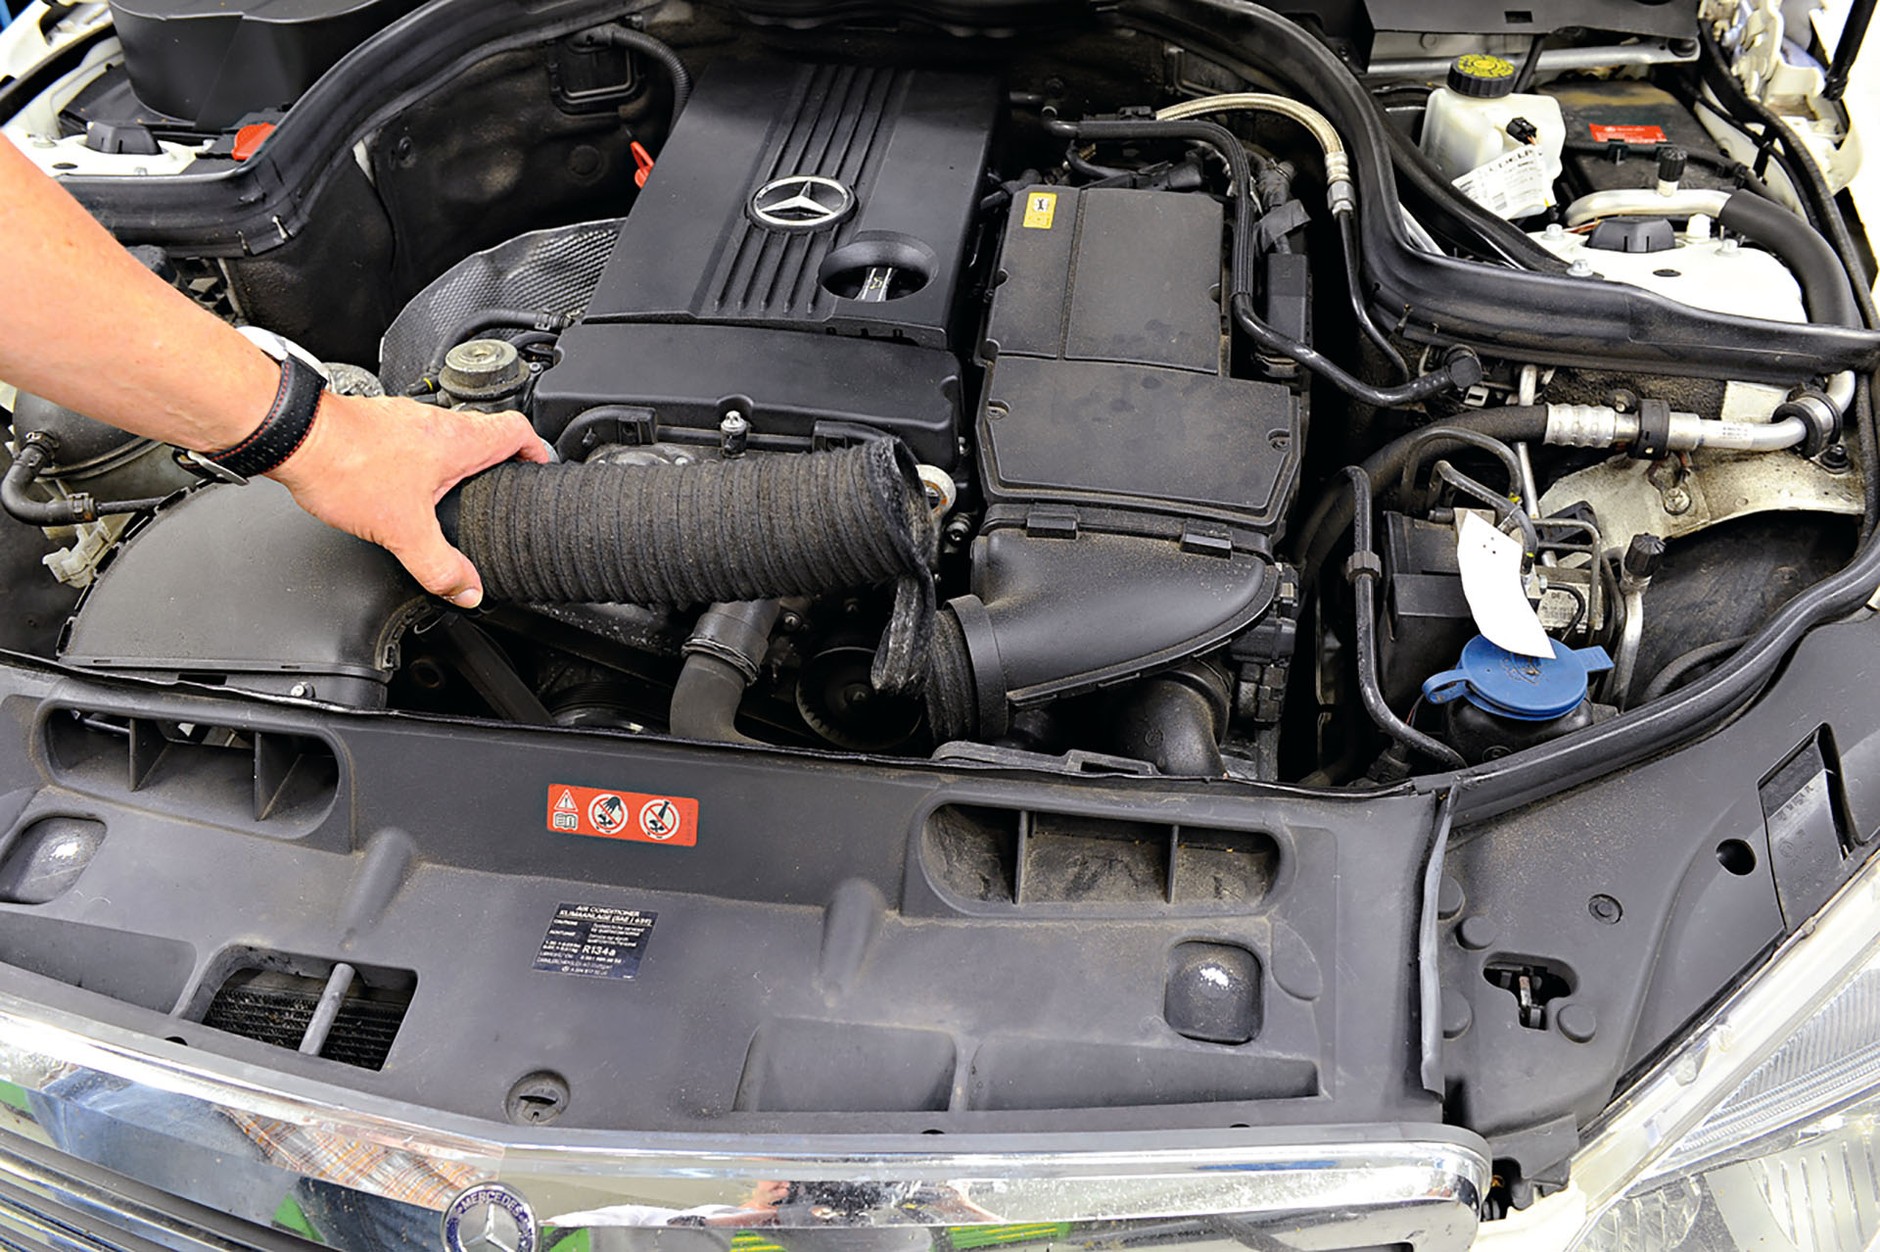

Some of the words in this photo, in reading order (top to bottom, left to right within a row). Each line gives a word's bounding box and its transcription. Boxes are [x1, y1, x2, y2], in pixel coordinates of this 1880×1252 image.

[590, 906, 640, 917] CONDITIONER
[582, 944, 616, 957] R134a
[461, 1191, 524, 1216] MERCEDES
